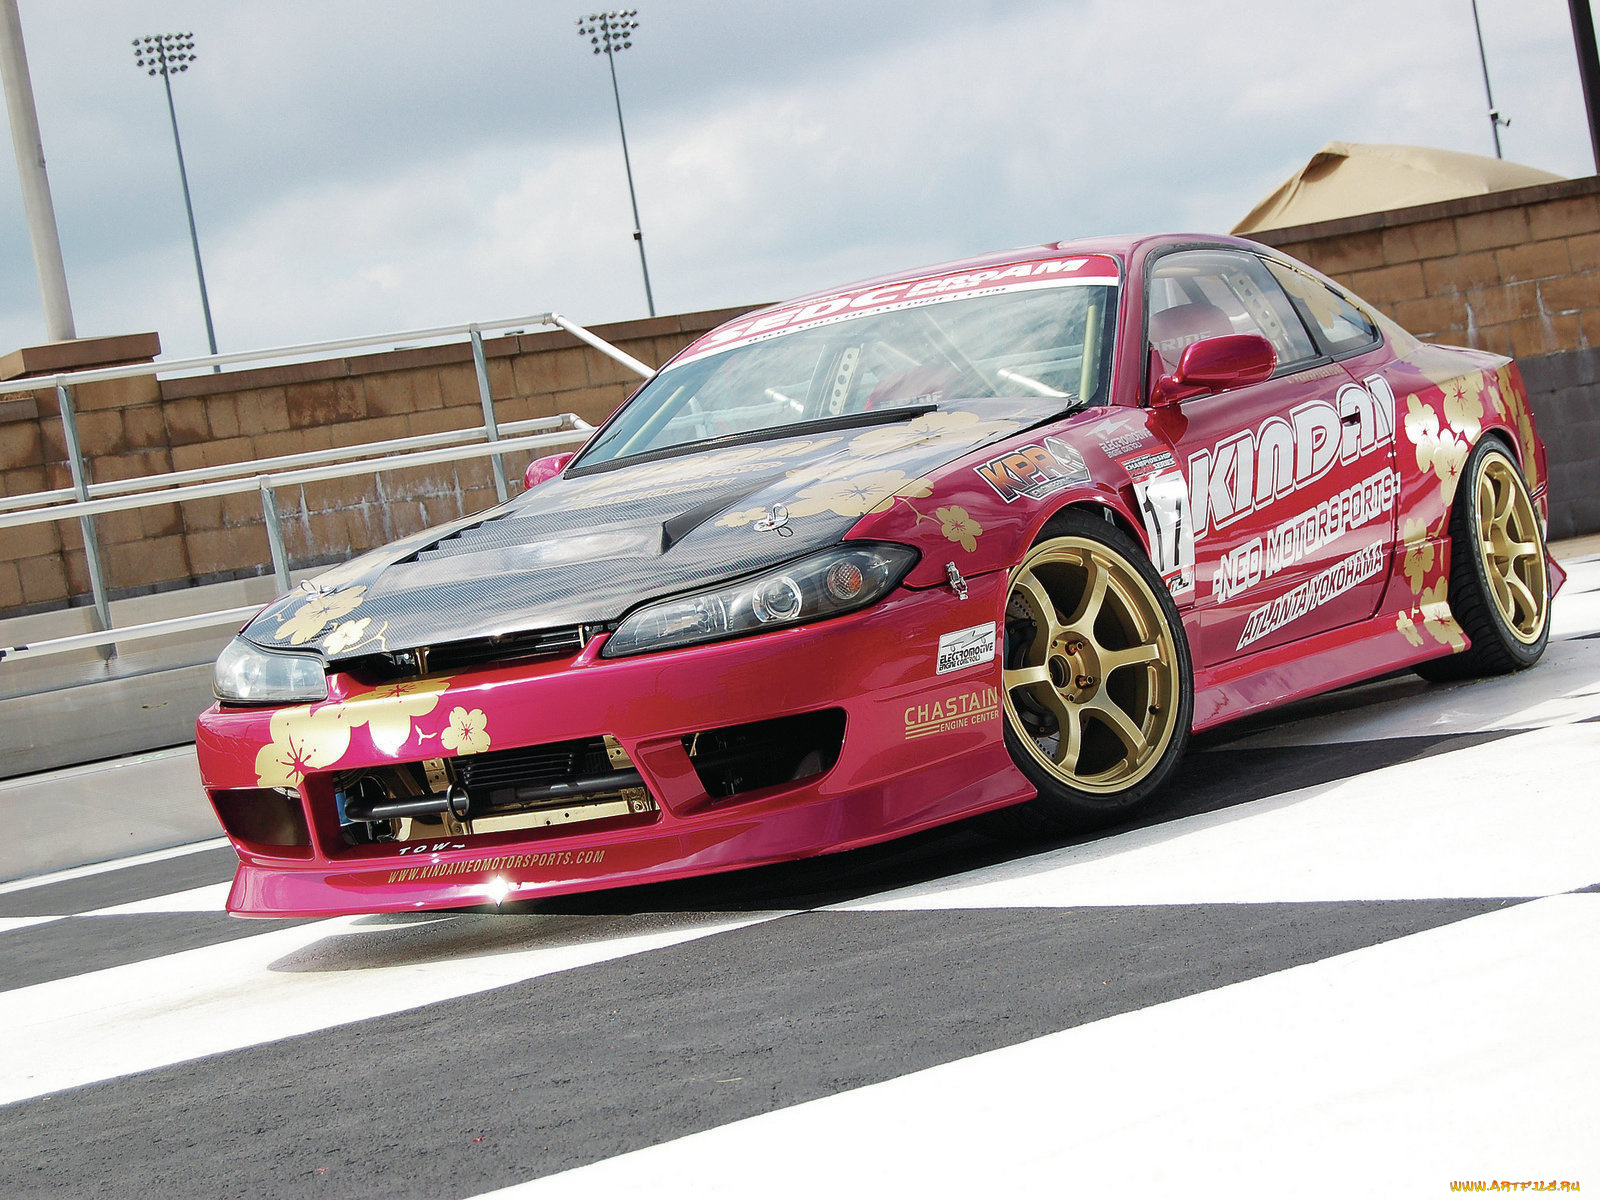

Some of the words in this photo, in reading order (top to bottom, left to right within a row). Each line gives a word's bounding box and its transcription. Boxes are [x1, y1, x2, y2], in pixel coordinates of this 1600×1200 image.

[973, 444, 1066, 503] KPR
[1188, 374, 1395, 543] KINDAI
[1217, 537, 1263, 604] NEO
[1265, 466, 1394, 578] MOTORSPORTS
[1236, 580, 1310, 651] ATLANTA
[1309, 539, 1384, 611] YOKOHAMA
[939, 642, 994, 664] ELECTROMOTIVE
[904, 686, 998, 725] CHASTAIN
[940, 718, 969, 732] ENGINE
[971, 709, 999, 725] CENTER
[388, 850, 606, 884] WWW.KINDAINEOMOTORSPORTS.COM
[400, 842, 450, 855] TOW
